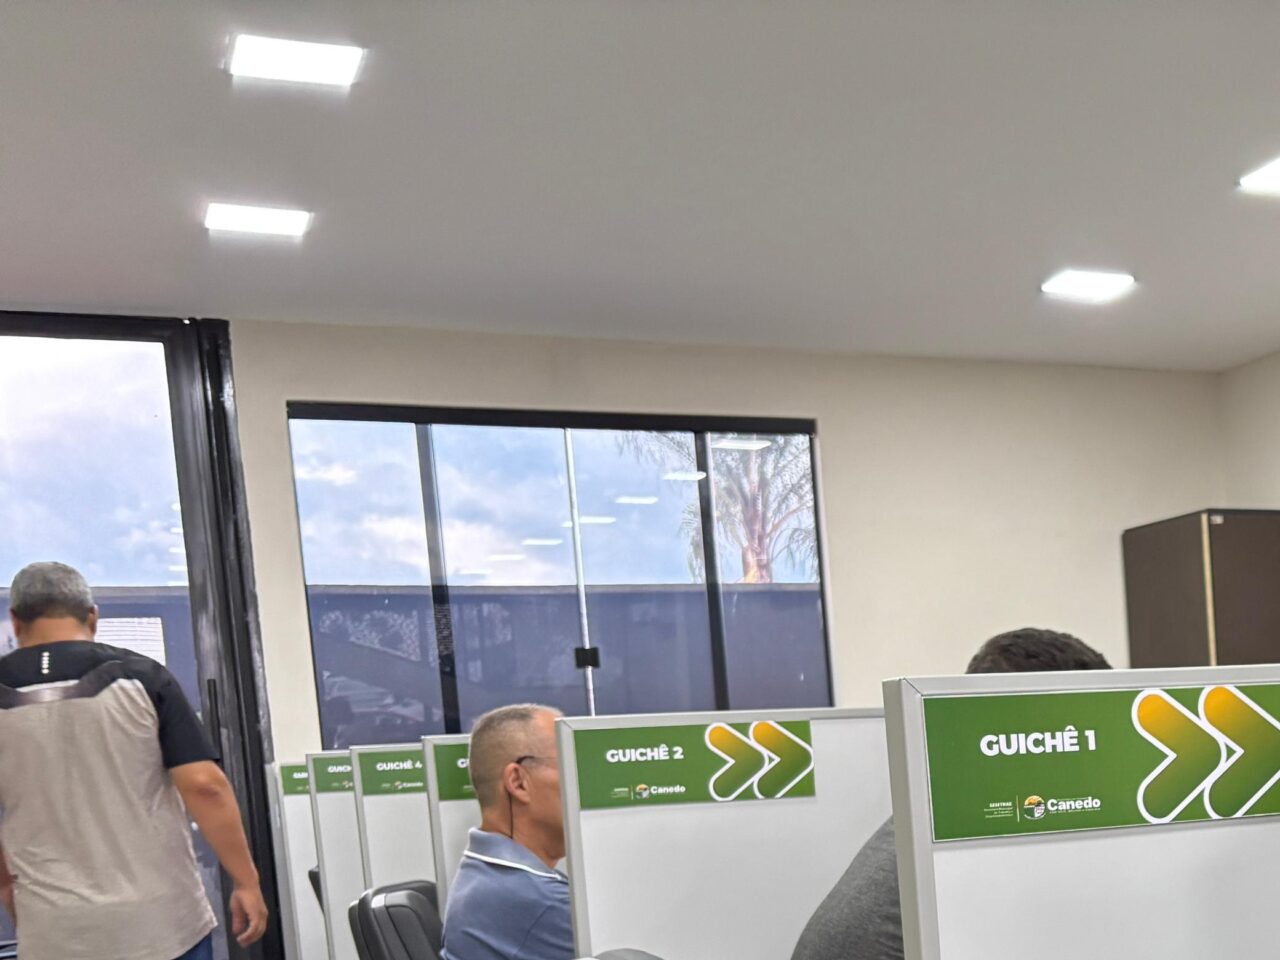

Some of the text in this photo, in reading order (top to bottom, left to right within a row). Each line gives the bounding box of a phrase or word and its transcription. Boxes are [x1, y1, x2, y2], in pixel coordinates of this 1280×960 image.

[980, 725, 1096, 756] GUICHÊ 1
[606, 743, 684, 763] GUICHÊ 2
[376, 759, 423, 771] GUICHÊ 4
[650, 784, 686, 794] Canedo
[1047, 797, 1101, 811] Canedo
